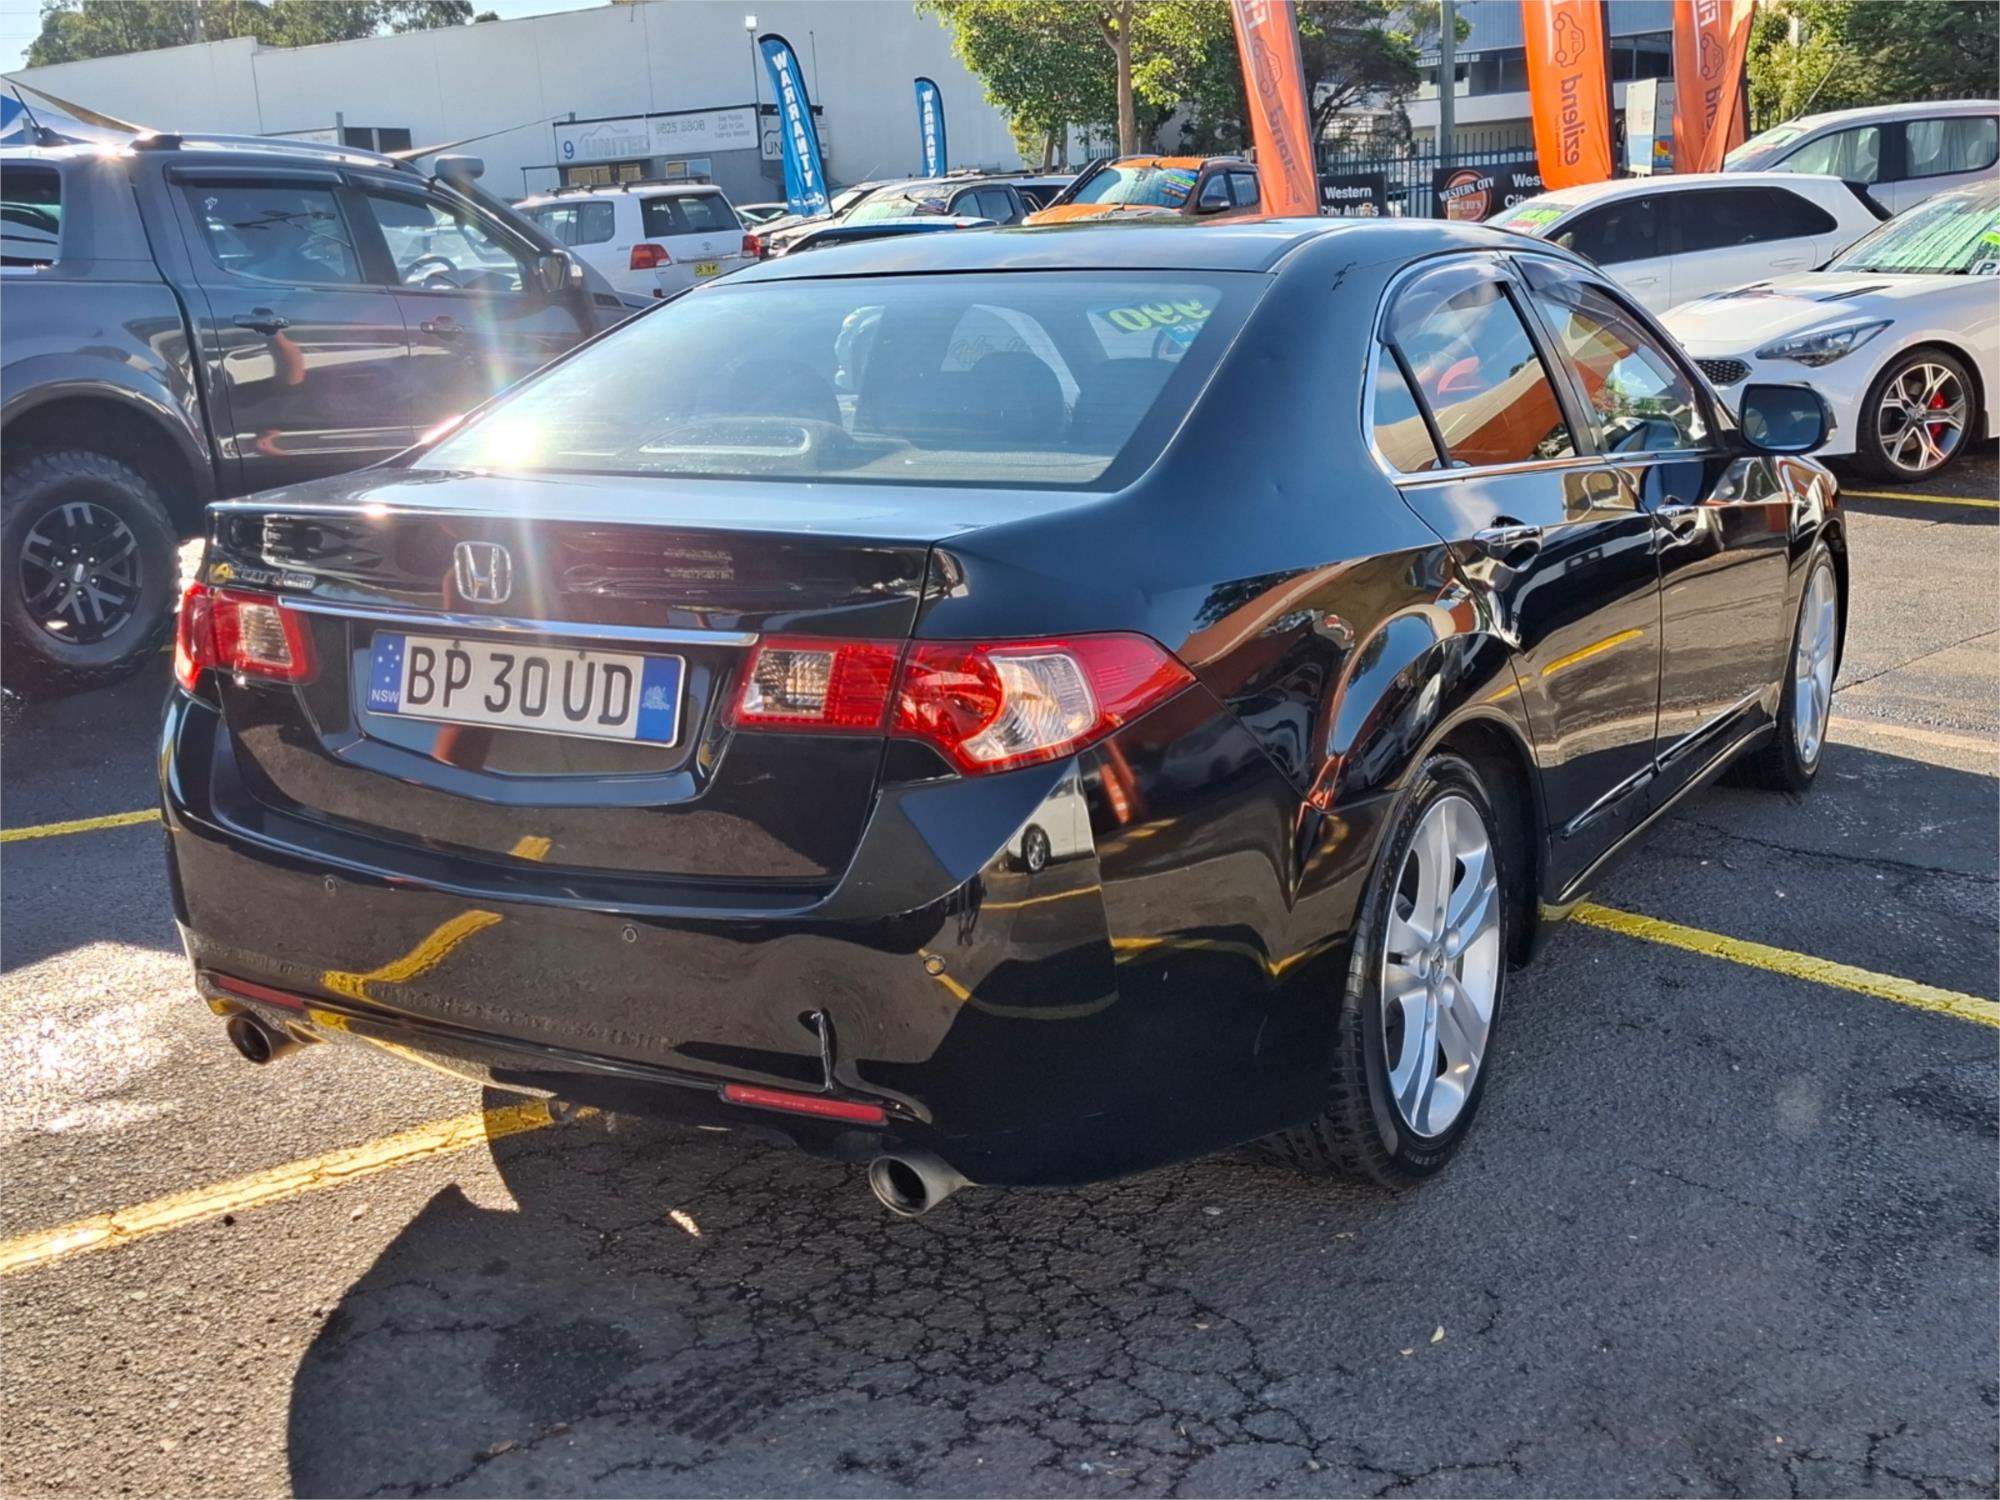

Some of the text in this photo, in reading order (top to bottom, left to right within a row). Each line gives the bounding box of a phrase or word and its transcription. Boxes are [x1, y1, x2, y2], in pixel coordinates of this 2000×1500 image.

[772, 51, 813, 187] WARRANTY
[563, 140, 575, 160] 9
[1477, 176, 1495, 190] CITY
[1324, 185, 1372, 199] Western
[1343, 204, 1379, 216] Auts
[406, 645, 633, 726] BP 30 UD
[371, 688, 400, 703] NSW
